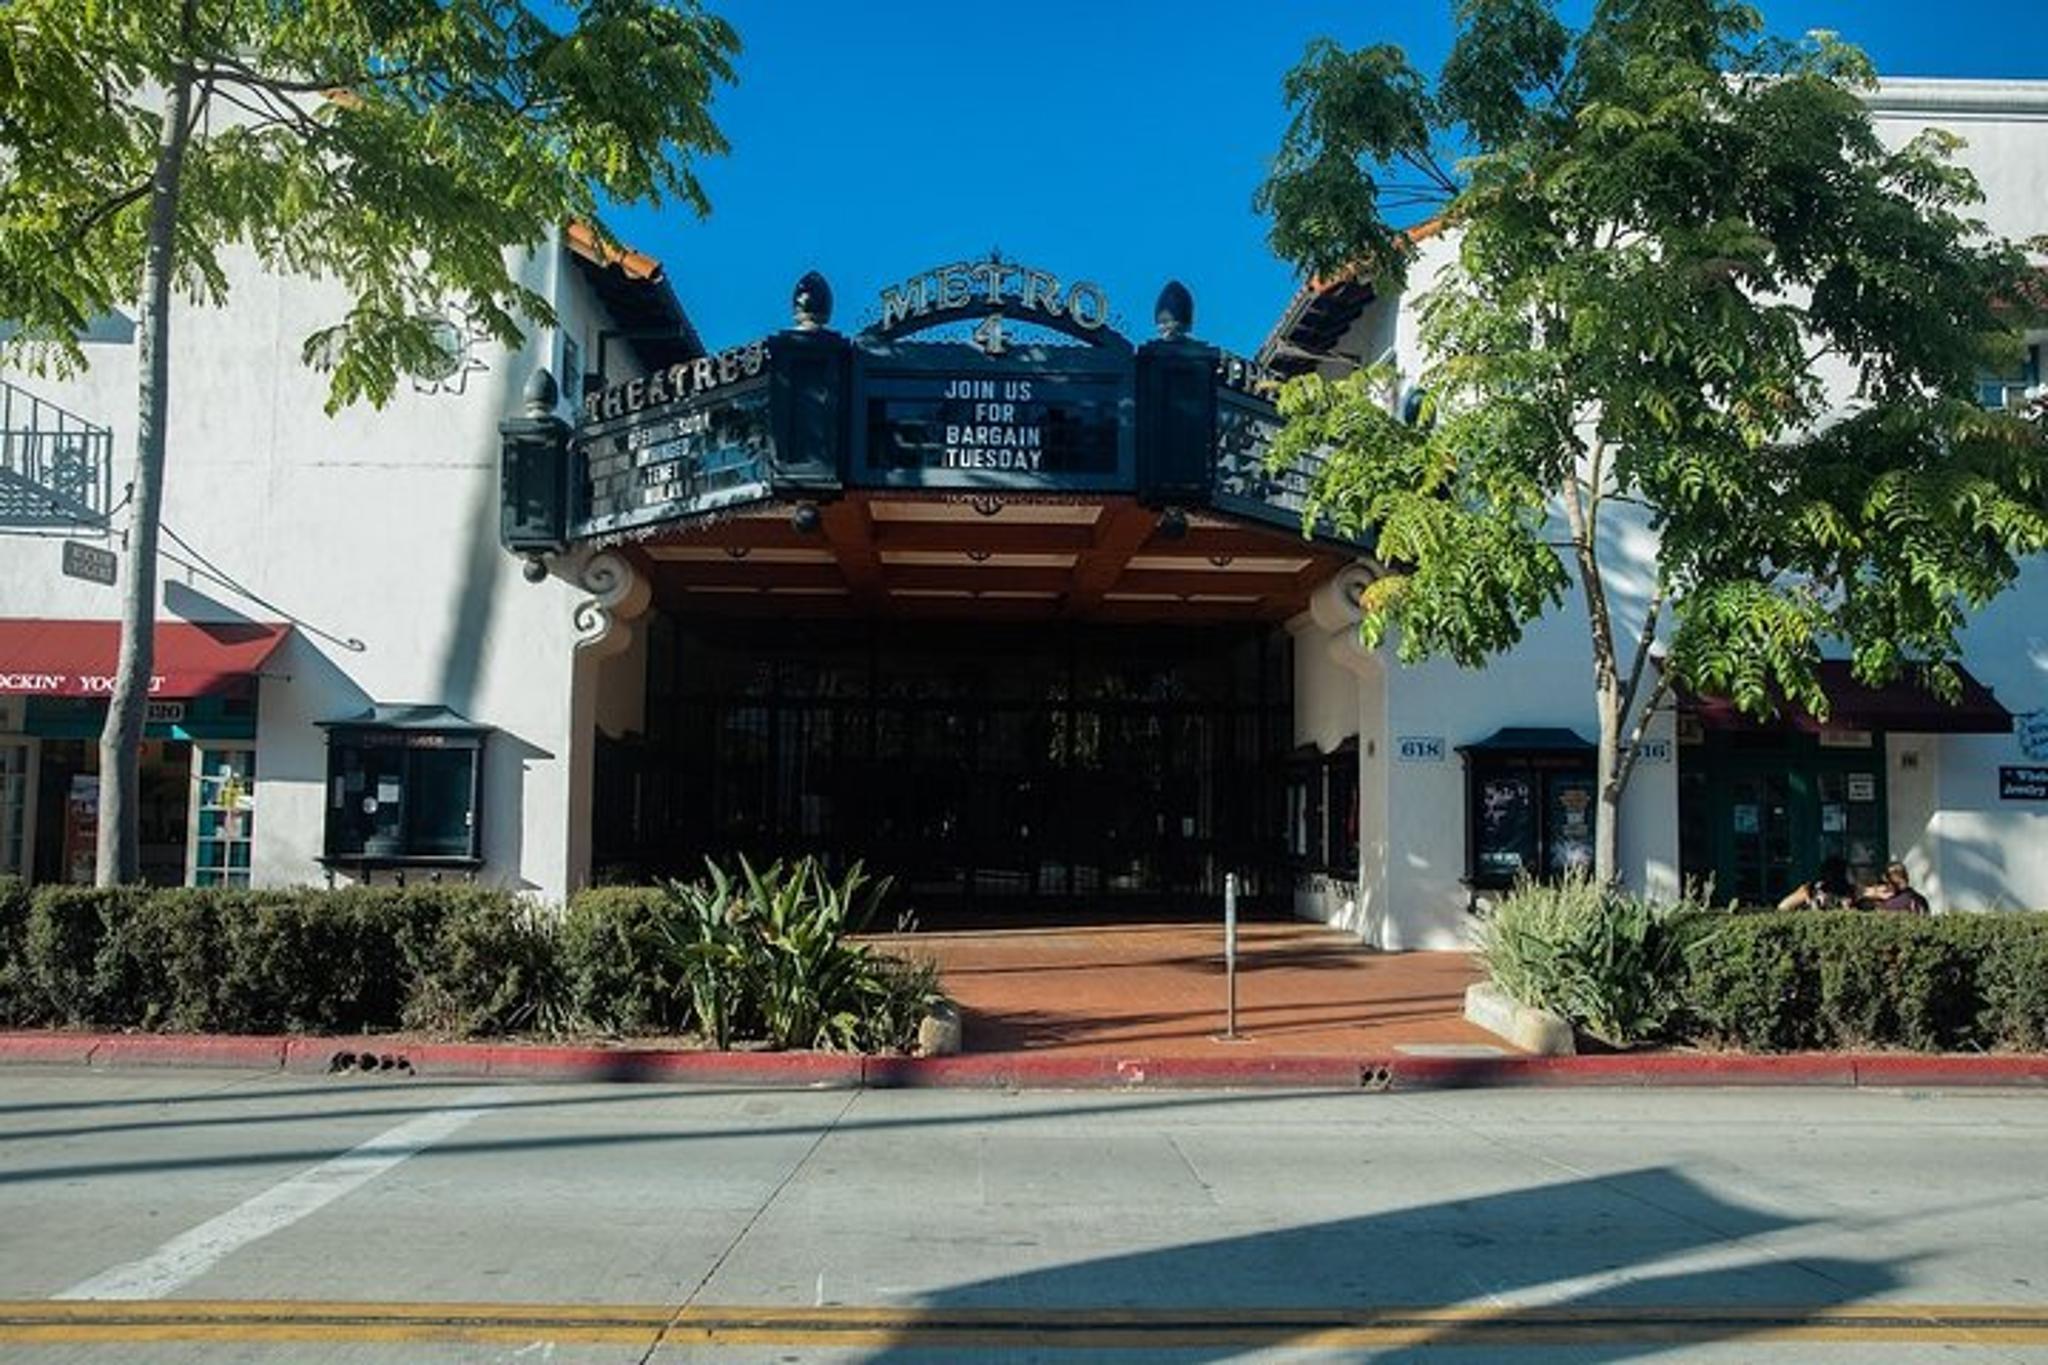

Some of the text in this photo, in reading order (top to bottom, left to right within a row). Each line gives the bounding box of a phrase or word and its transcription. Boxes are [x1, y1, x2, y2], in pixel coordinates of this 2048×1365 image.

[881, 263, 1107, 330] METRO
[586, 340, 764, 422] THEATRES
[945, 381, 1032, 400] JOIN US
[975, 404, 1014, 423] FOR
[946, 426, 1041, 446] BARGAIN
[946, 449, 1043, 469] TUESDAY
[1401, 741, 1440, 757] 618
